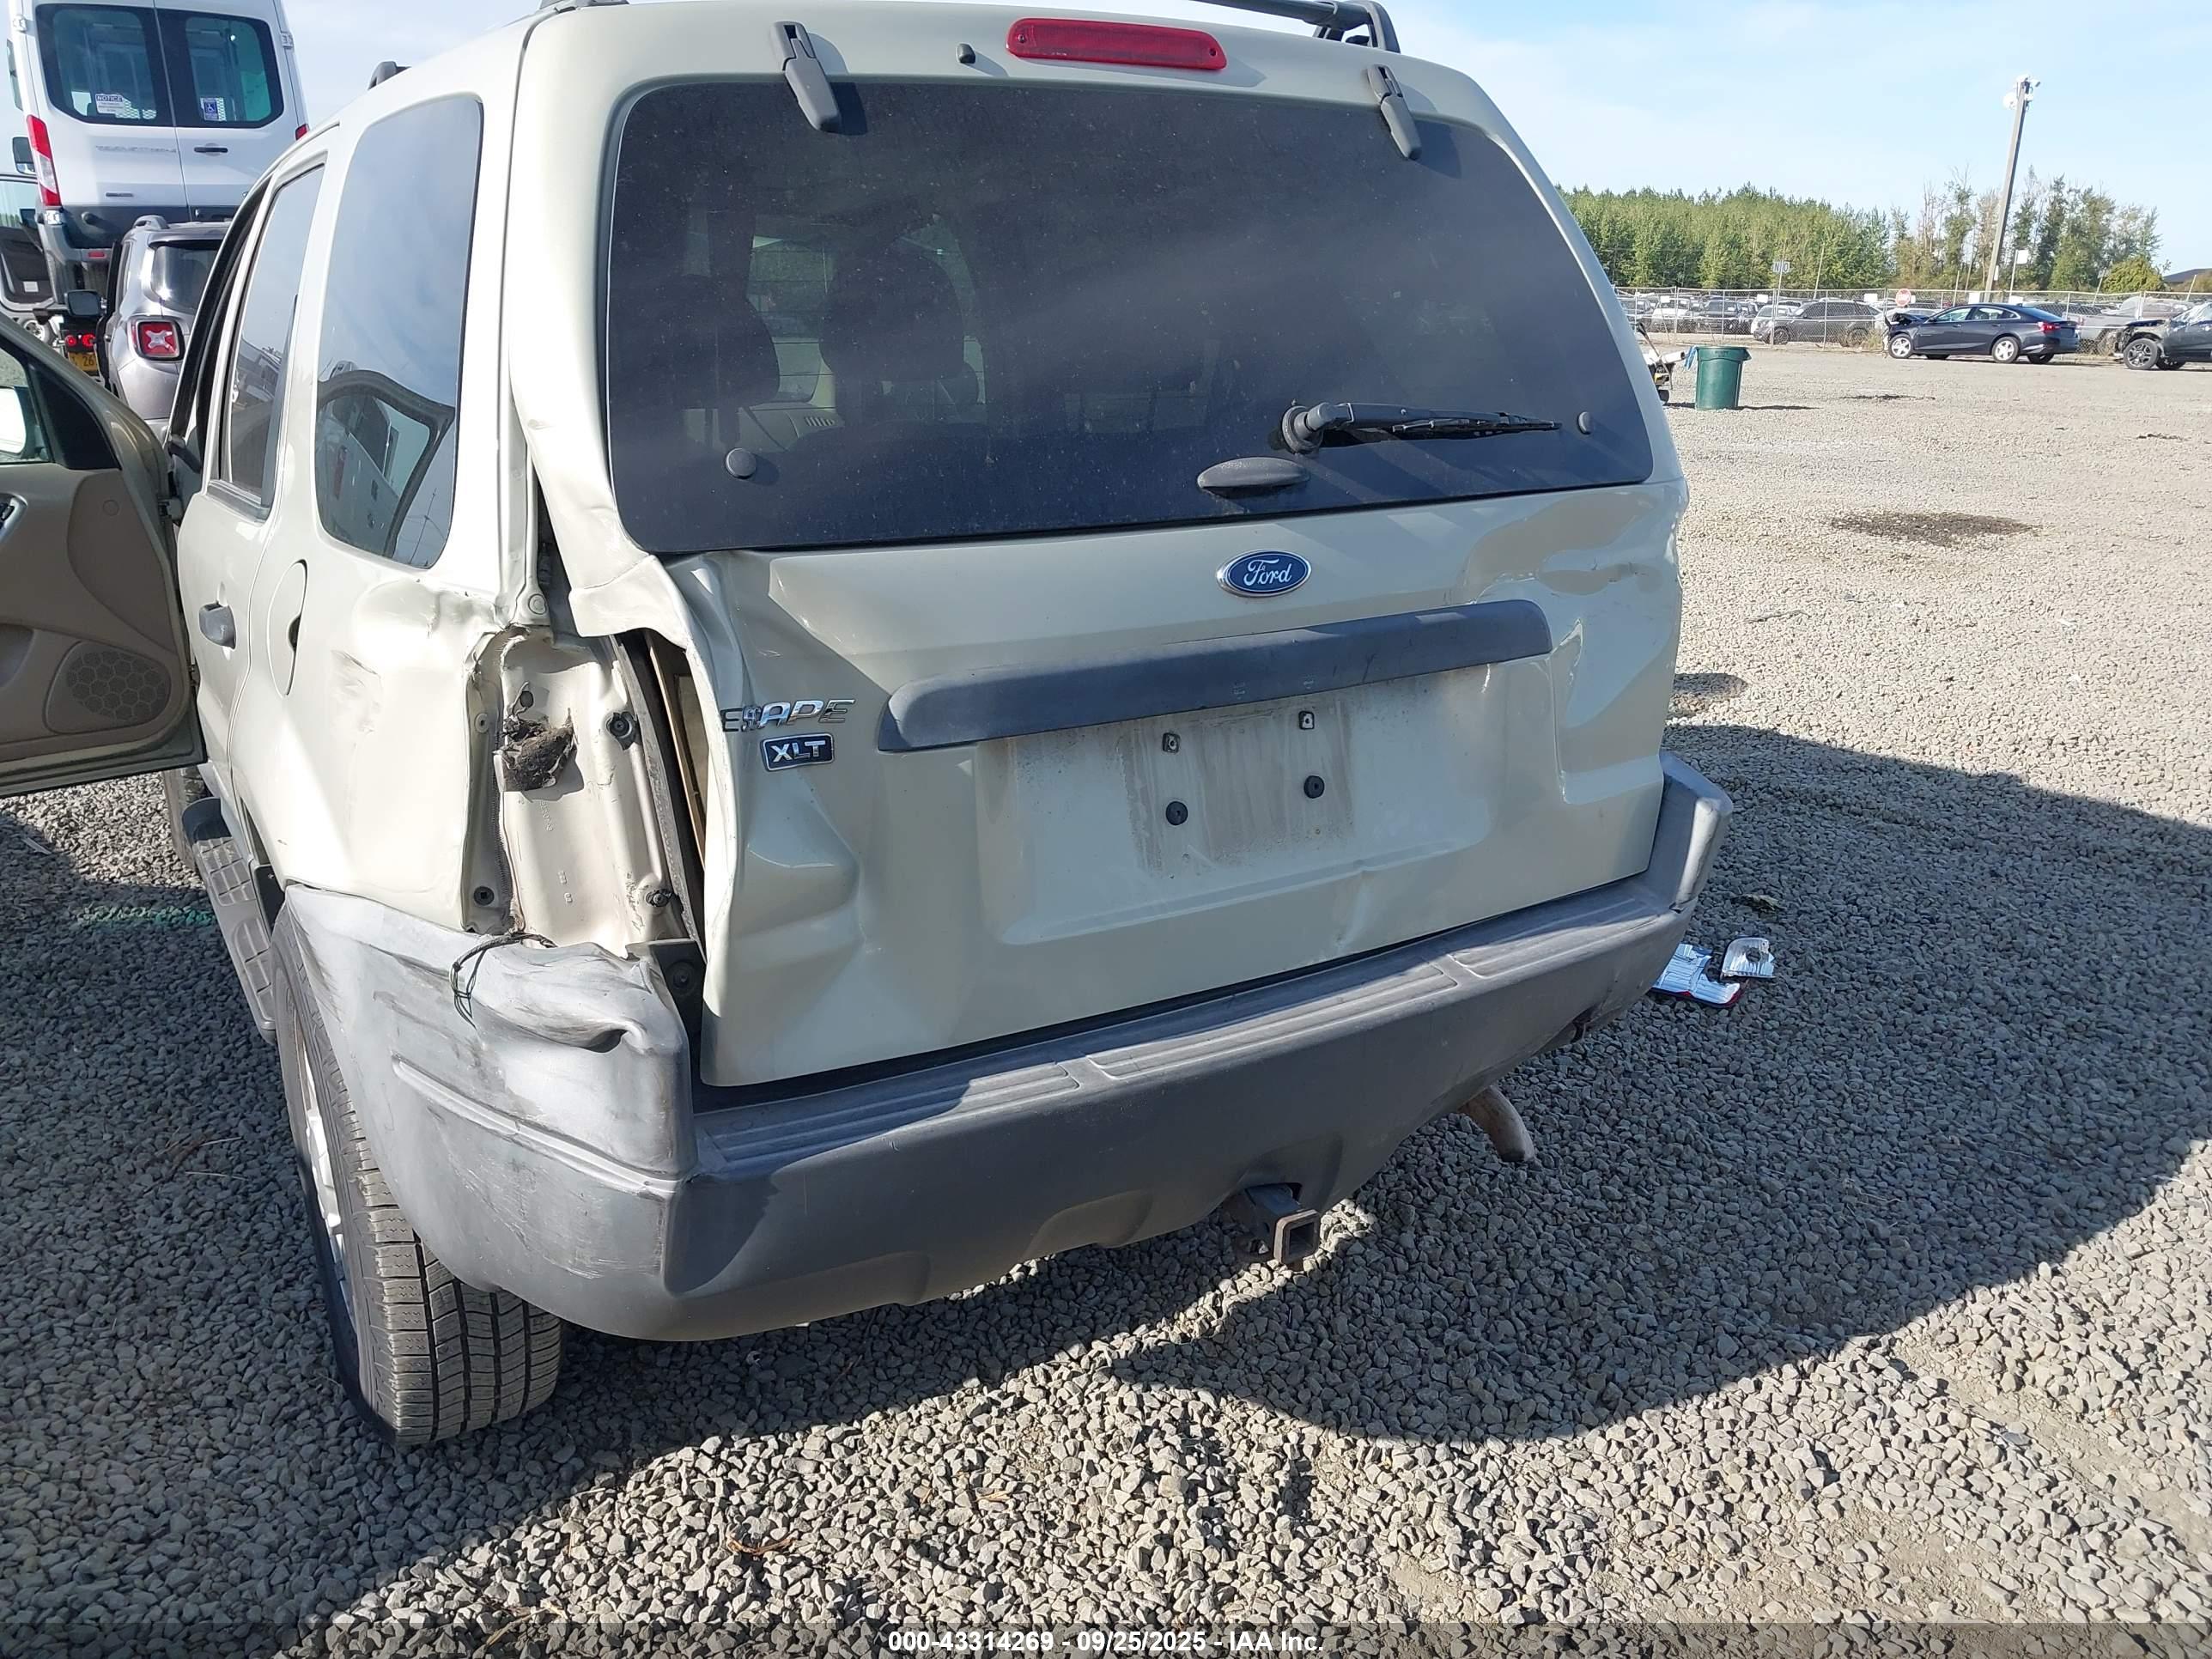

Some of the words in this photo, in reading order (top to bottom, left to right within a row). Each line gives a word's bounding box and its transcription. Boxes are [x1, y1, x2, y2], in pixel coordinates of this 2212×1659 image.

[1243, 558, 1291, 586] Ford
[720, 699, 856, 732] EAPE
[770, 740, 826, 763] XLT
